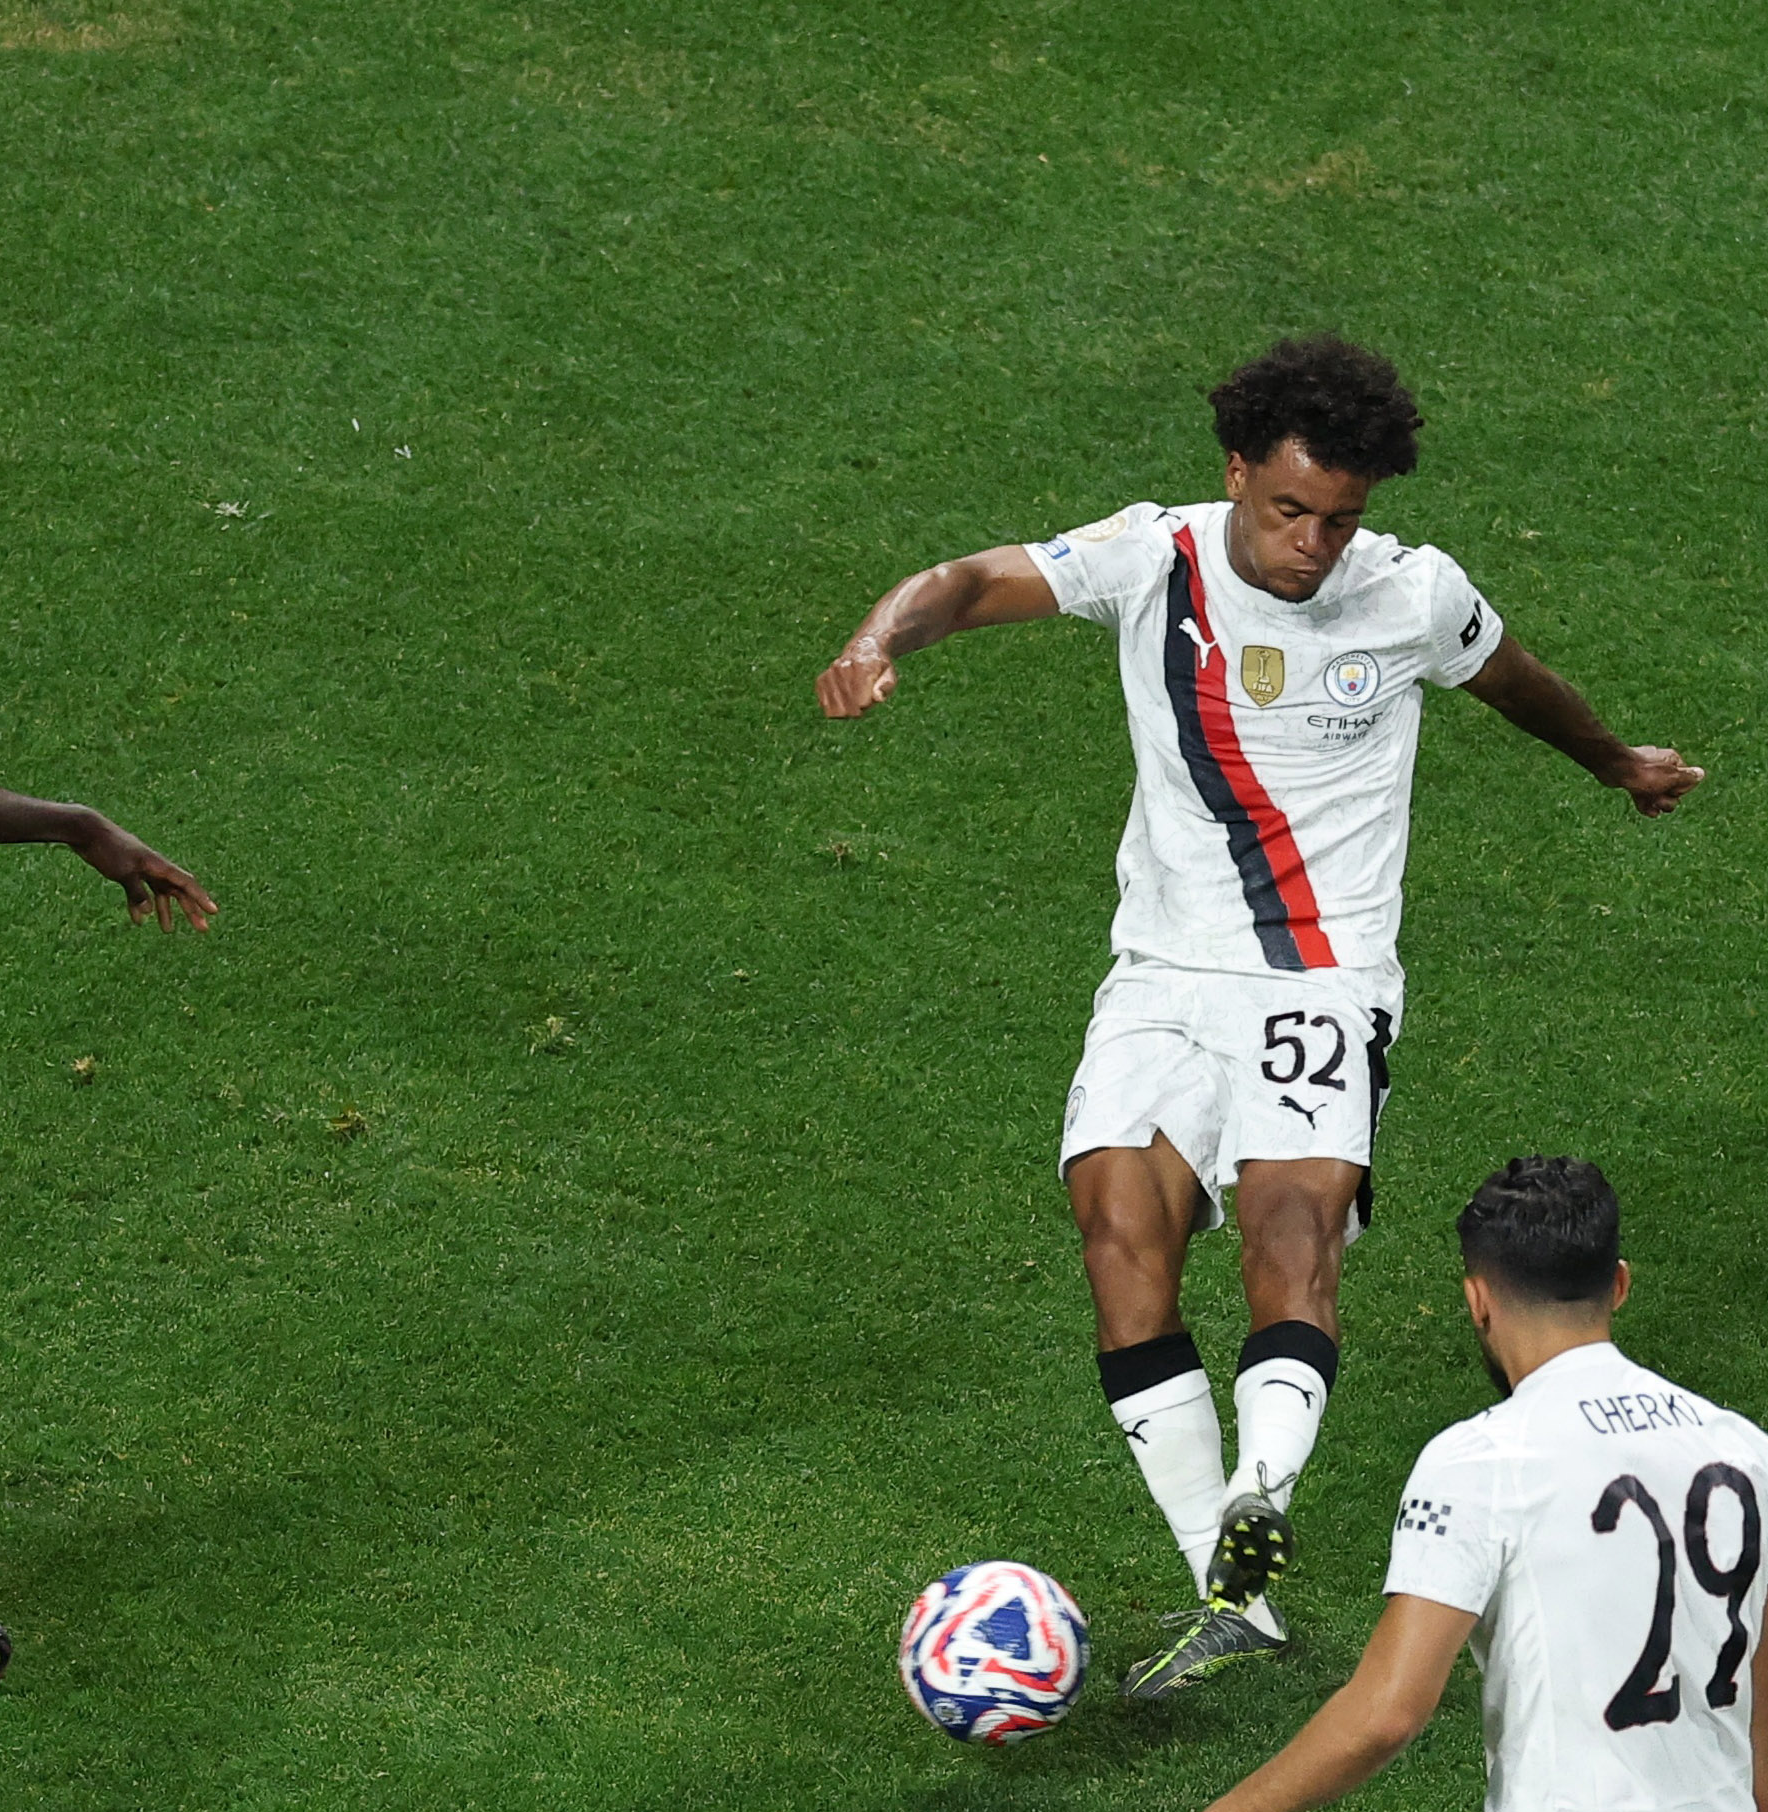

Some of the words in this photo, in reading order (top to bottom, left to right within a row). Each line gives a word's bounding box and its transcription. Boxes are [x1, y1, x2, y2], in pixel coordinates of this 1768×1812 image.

[1261, 1010, 1346, 1091] 52
[1578, 1391, 1704, 1435] CHERKI
[1591, 1461, 1761, 1732] 29
